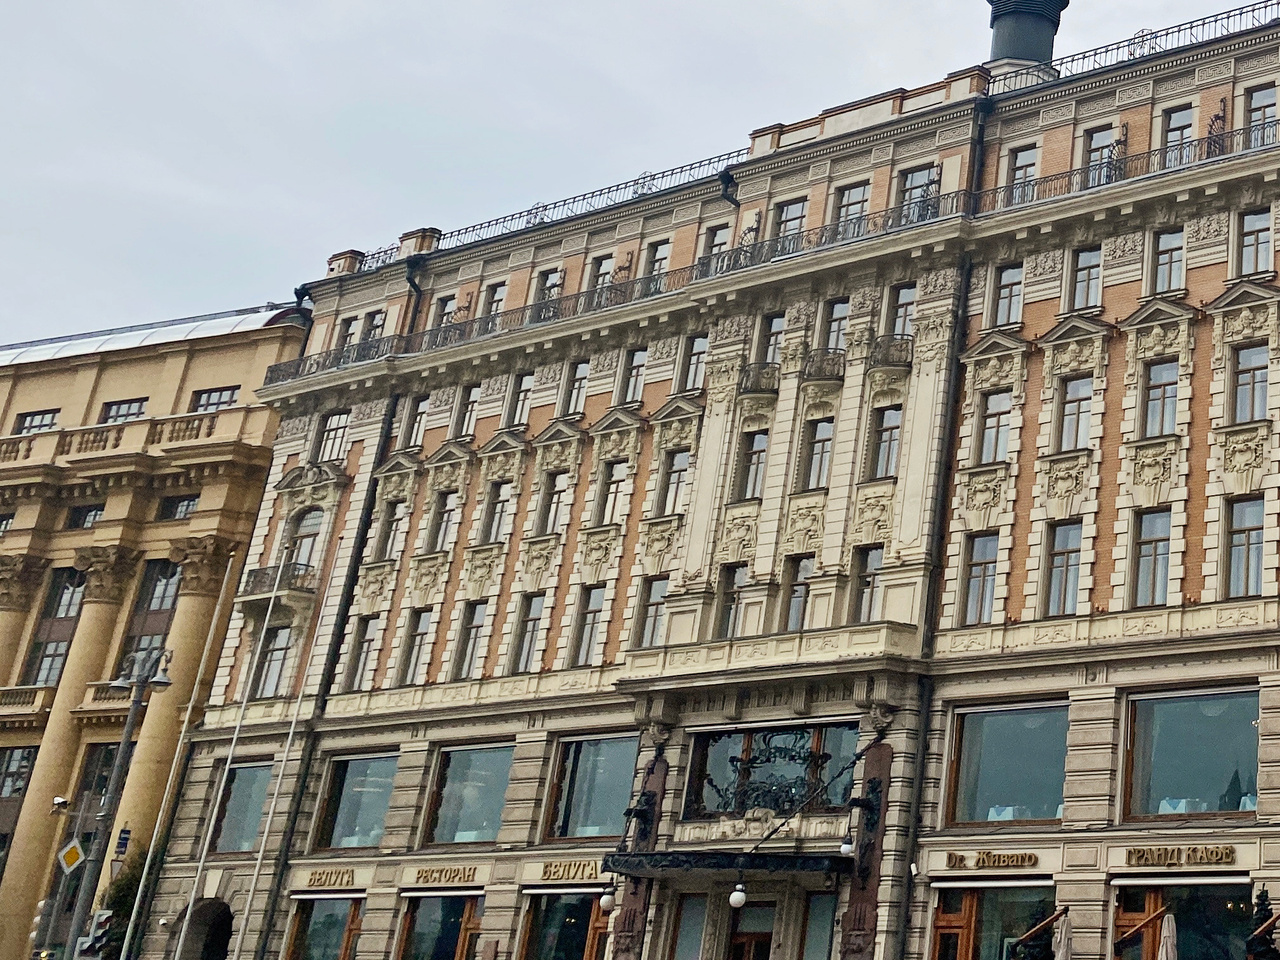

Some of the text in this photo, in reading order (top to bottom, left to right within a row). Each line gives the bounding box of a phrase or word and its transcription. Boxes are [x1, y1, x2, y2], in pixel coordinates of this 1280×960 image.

[945, 850, 1039, 869] Dr. Живаго
[1125, 845, 1236, 867] ГРАНД КАФЕ
[307, 868, 354, 887] БЕЛУГА
[415, 866, 478, 884] РЕСТОРАН
[541, 860, 598, 880] БЕЛУГА
